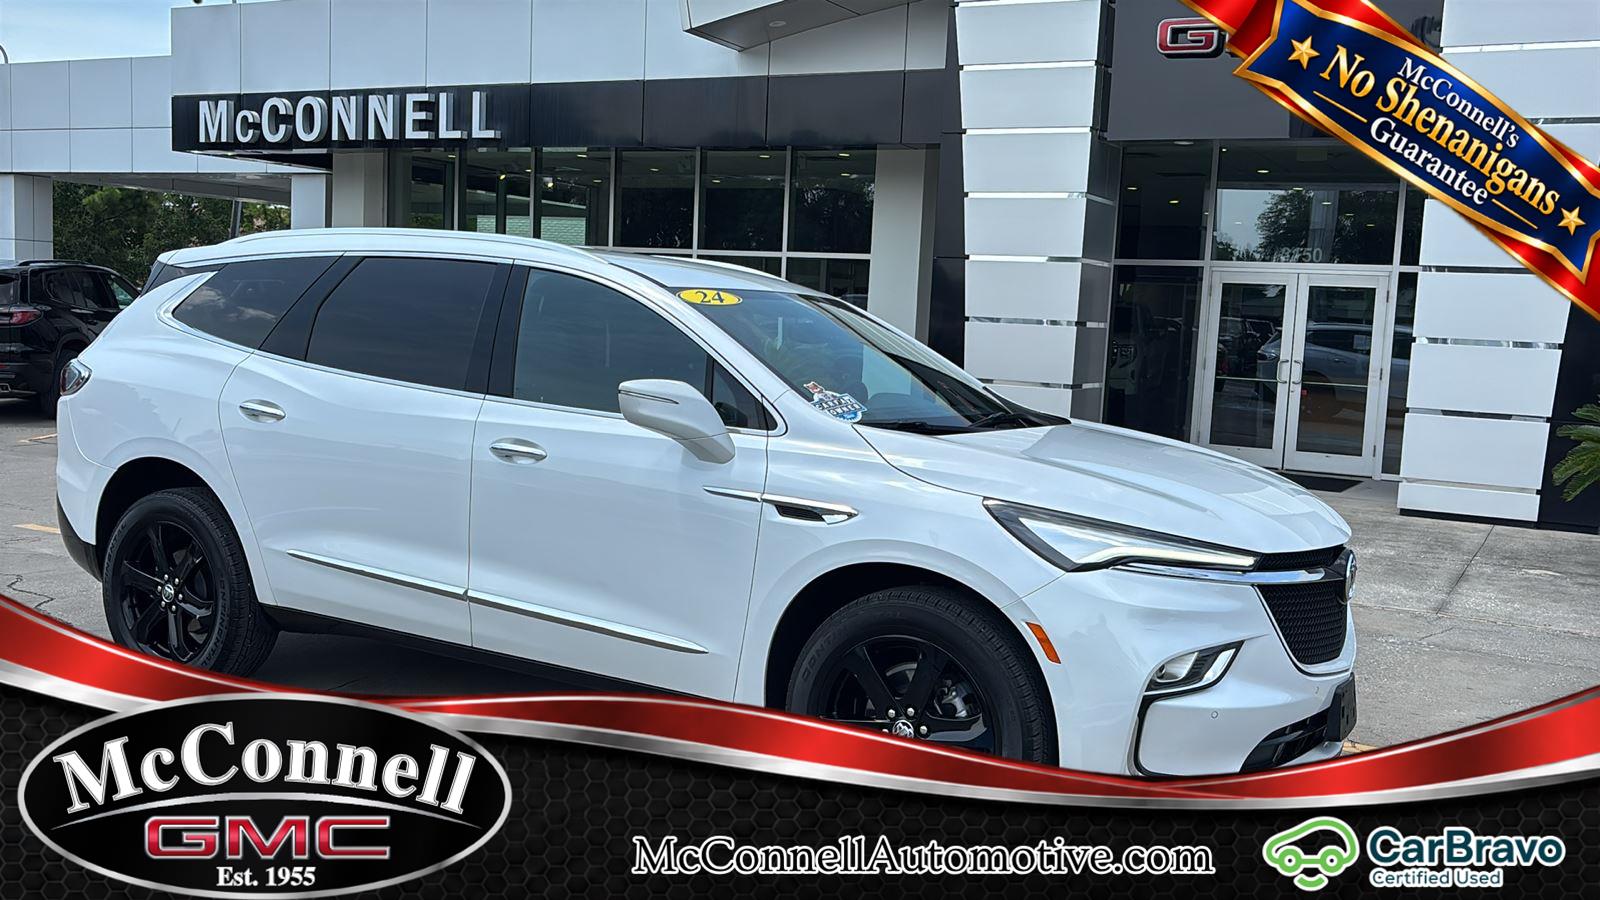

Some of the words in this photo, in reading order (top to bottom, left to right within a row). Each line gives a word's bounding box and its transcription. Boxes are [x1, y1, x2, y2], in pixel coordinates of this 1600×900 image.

[1156, 17, 1229, 57] G
[198, 90, 502, 144] McCONNELL
[694, 290, 726, 304] 24
[829, 403, 861, 415] OWNER
